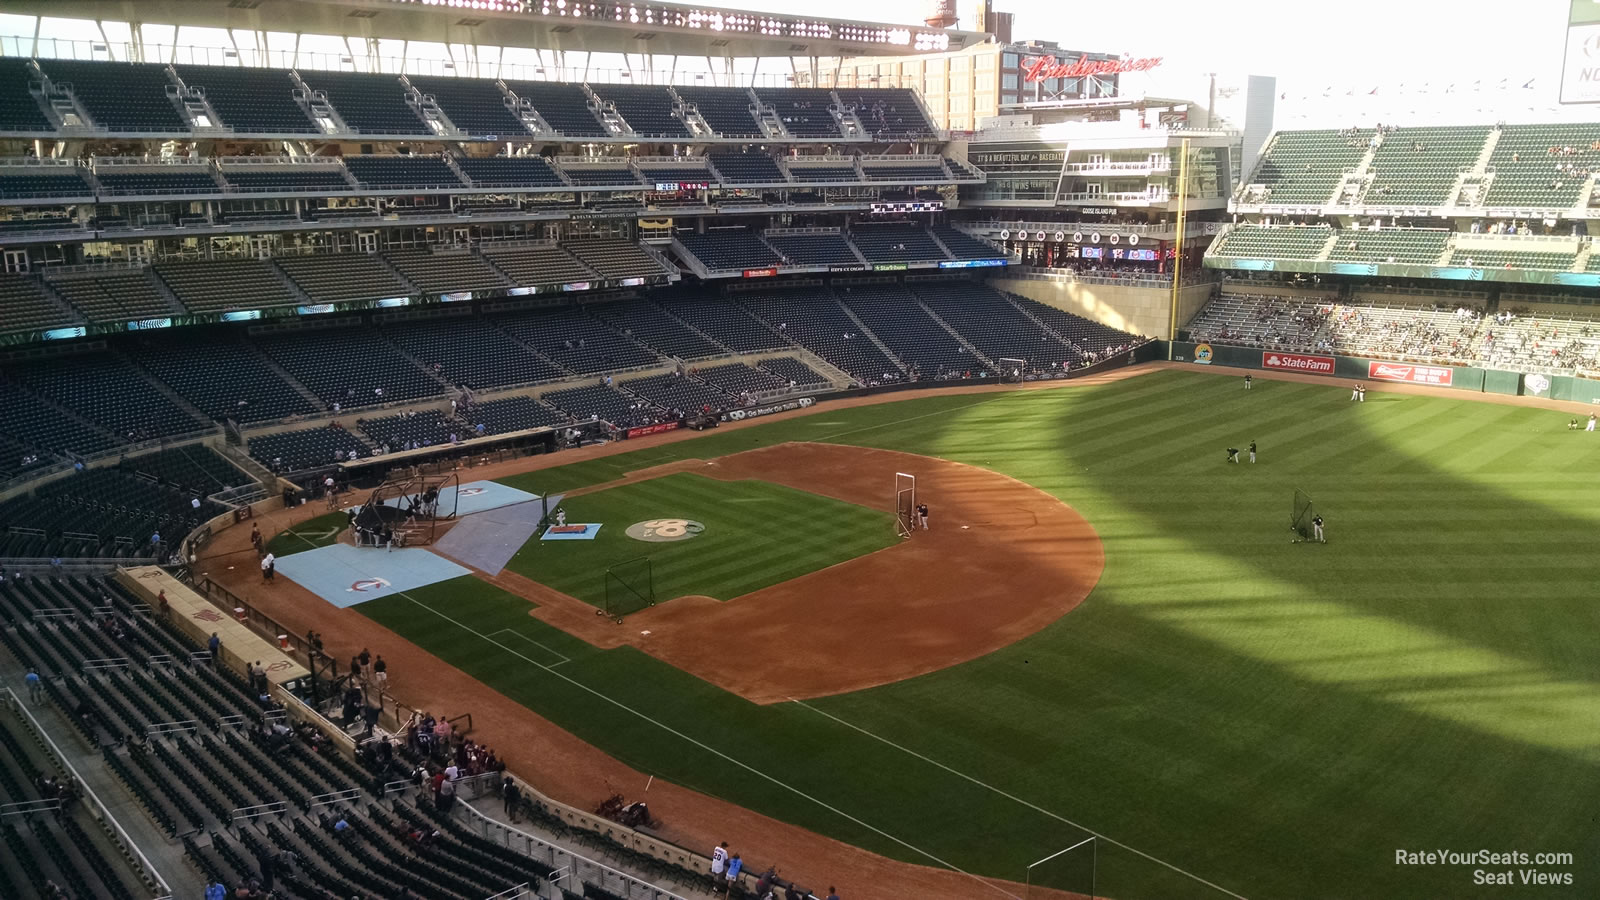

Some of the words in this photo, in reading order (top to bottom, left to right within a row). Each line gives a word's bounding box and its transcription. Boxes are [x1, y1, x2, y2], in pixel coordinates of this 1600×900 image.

[1021, 52, 1162, 82] Budweiser
[993, 153, 1020, 162] BEAUTIFUL
[1021, 153, 1030, 161] DAY
[1039, 152, 1064, 161] BASEBALL
[1011, 181, 1030, 190] TWINS
[1082, 207, 1095, 215] GOOSE
[1535, 379, 1548, 389] 29
[757, 407, 774, 416] Music
[774, 405, 782, 413] Go
[782, 402, 798, 410] Twins
